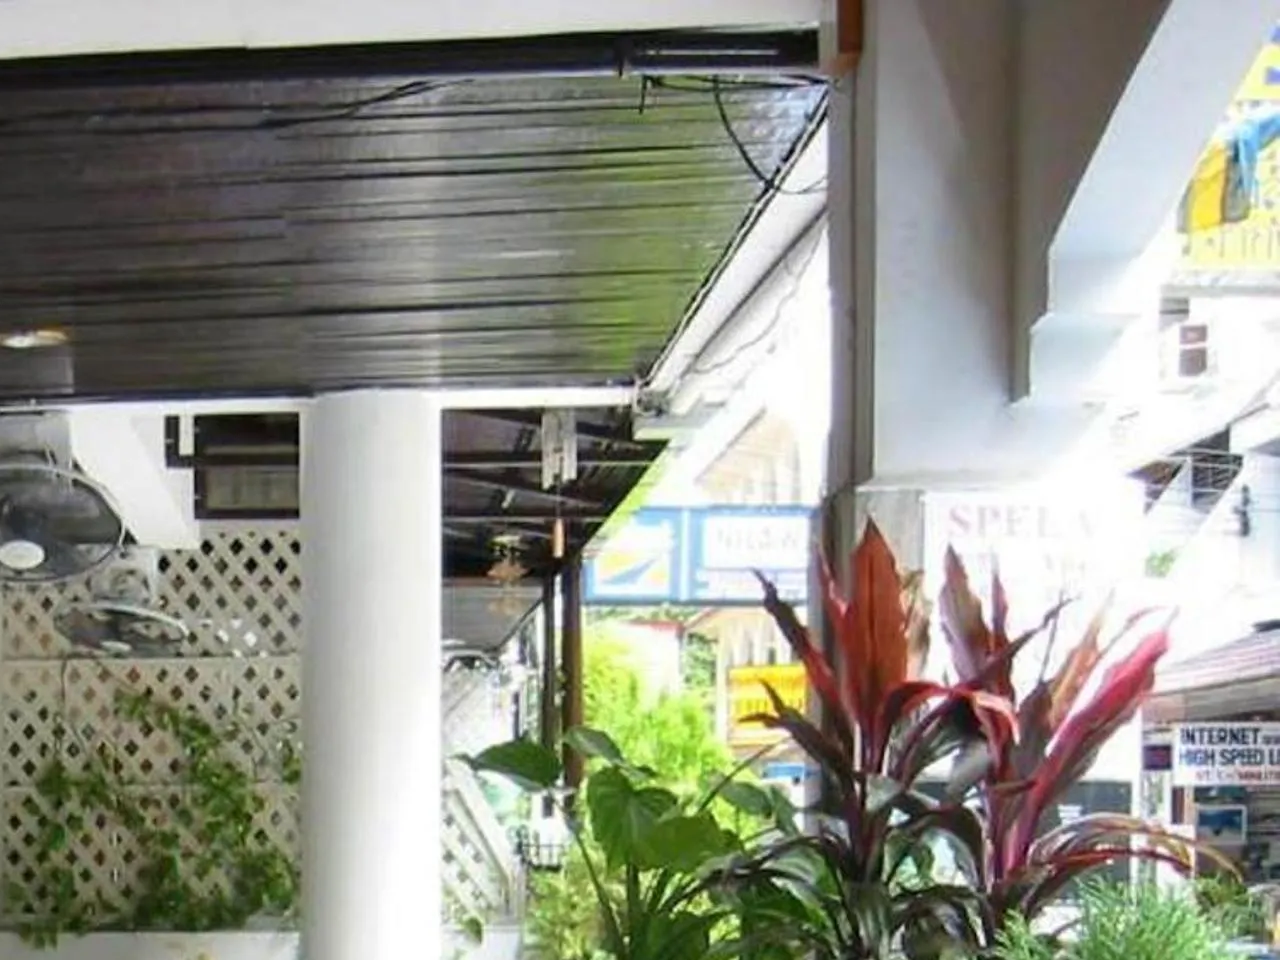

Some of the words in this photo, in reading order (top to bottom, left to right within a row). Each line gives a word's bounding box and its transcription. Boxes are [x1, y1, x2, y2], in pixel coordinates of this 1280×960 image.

[1180, 727, 1260, 745] INTERNET
[1179, 748, 1215, 766] HIGH
[1219, 748, 1264, 766] SPEED
